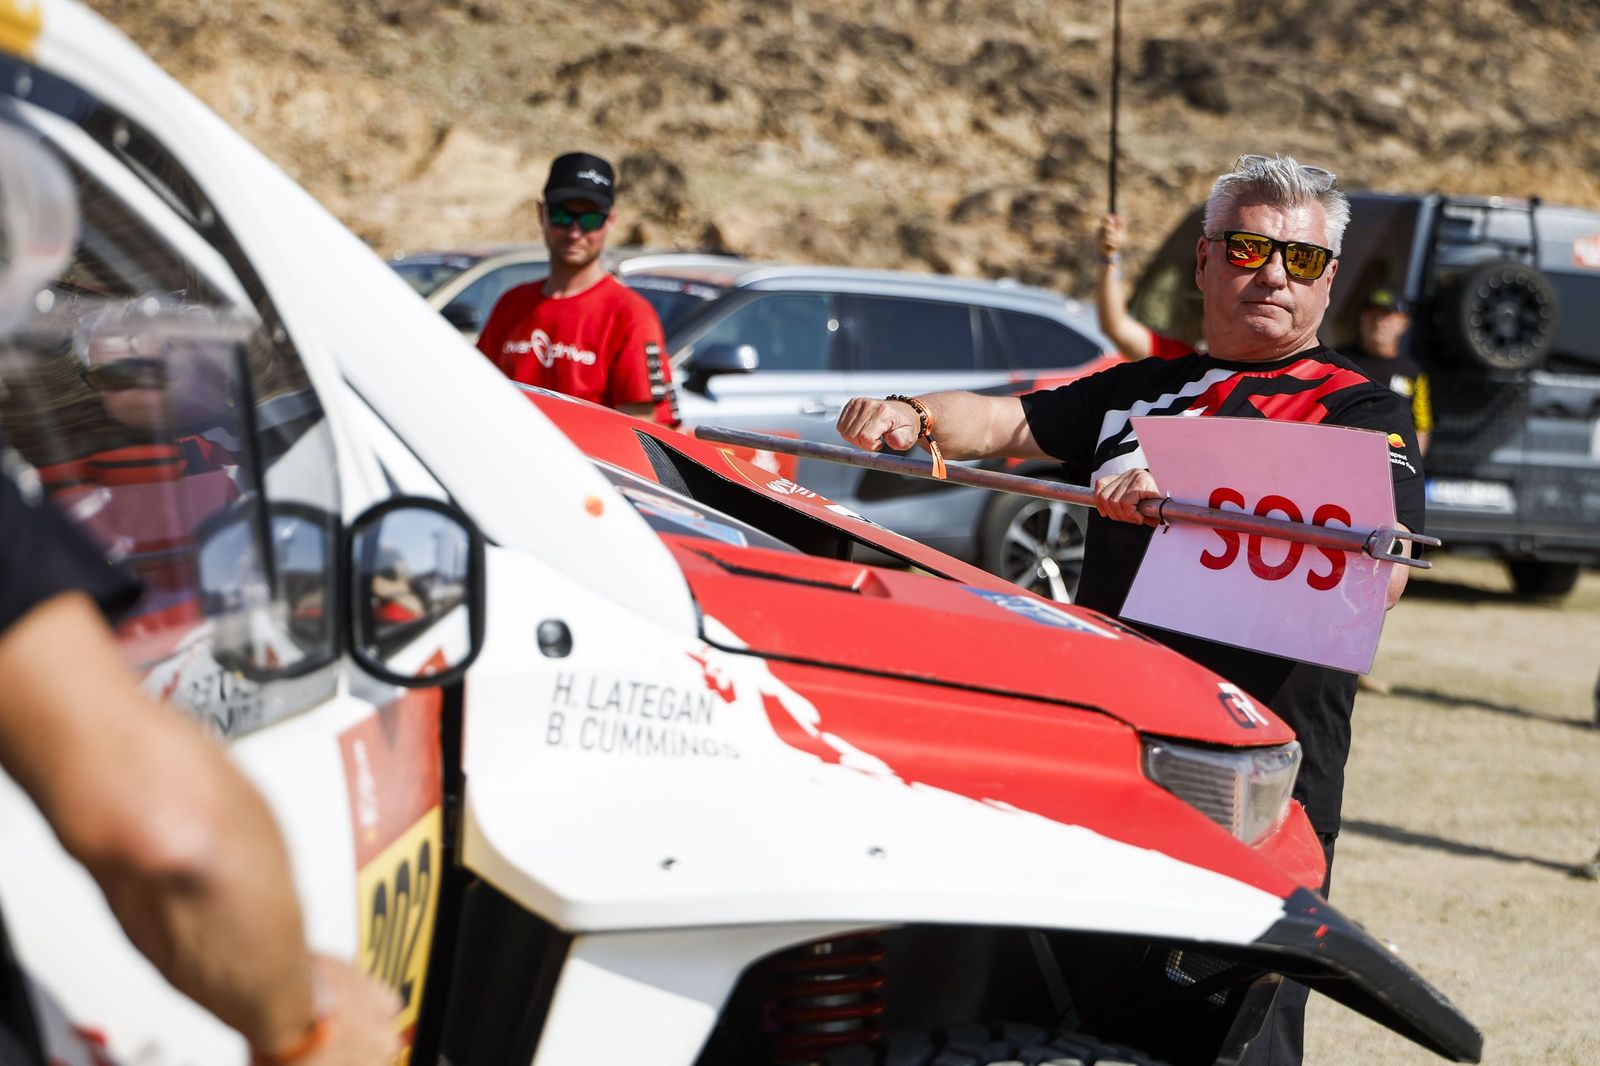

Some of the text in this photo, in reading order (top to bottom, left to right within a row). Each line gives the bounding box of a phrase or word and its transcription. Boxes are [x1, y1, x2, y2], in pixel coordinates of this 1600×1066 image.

[1199, 487, 1352, 591] SOS
[553, 672, 717, 725] H. LATEGAN
[546, 712, 741, 759] B. CUMMINGS
